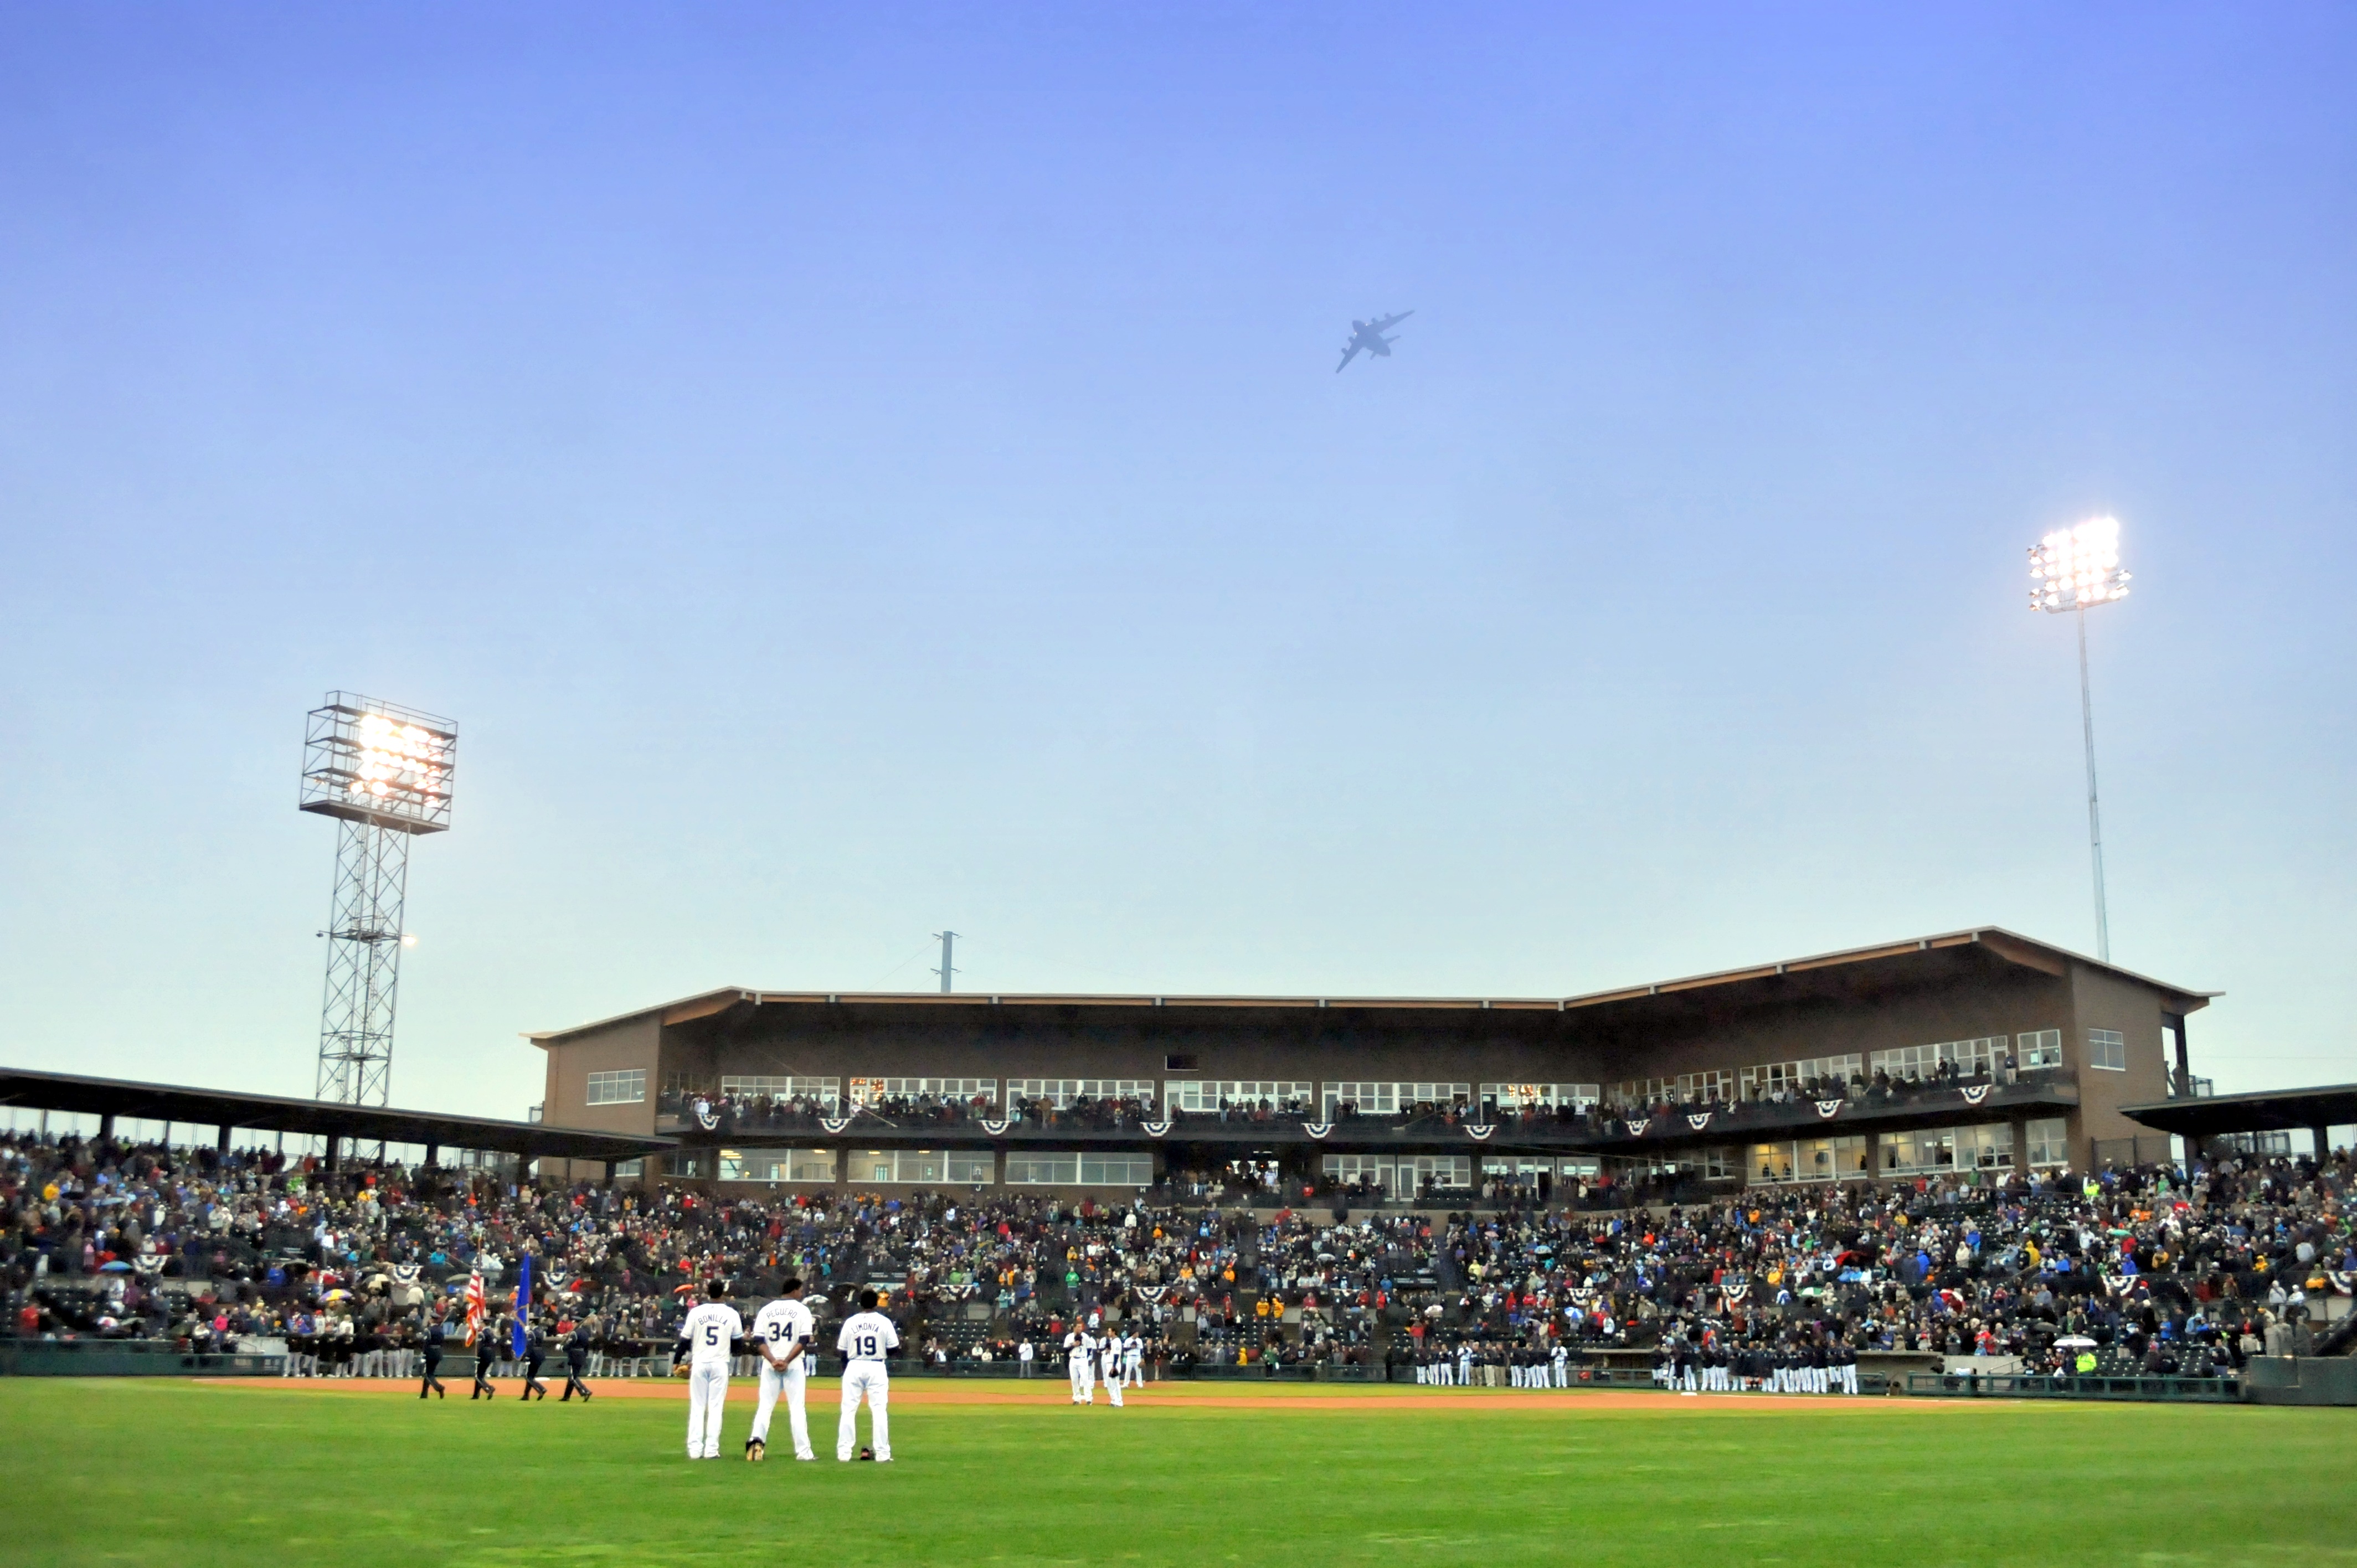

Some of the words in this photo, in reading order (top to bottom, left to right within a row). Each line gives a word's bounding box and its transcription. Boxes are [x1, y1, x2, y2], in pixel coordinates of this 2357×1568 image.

[698, 1314, 728, 1326] BONILLA
[766, 1308, 797, 1319] PEGUERO
[706, 1325, 719, 1346] 5
[769, 1322, 792, 1342] 34
[851, 1322, 879, 1334] LIMONTA
[855, 1335, 877, 1356] 19
